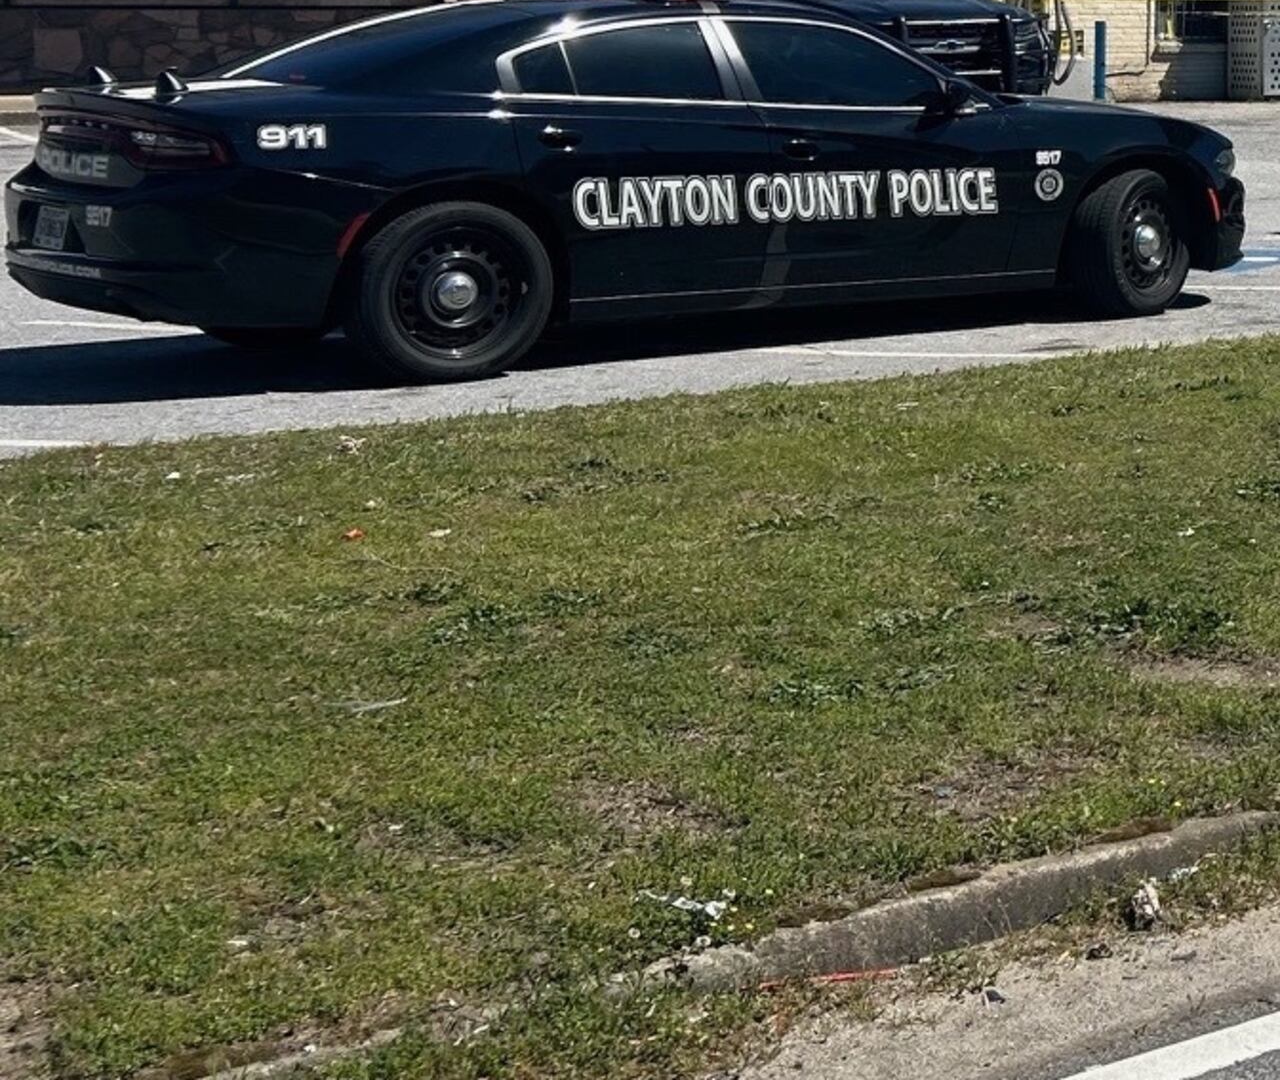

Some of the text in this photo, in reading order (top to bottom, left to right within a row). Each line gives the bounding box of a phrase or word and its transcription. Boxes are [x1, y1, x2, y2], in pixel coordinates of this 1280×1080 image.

[257, 123, 327, 150] 911
[40, 147, 110, 179] POLICE
[573, 167, 998, 230] CLAYTON COUNTY POLICE
